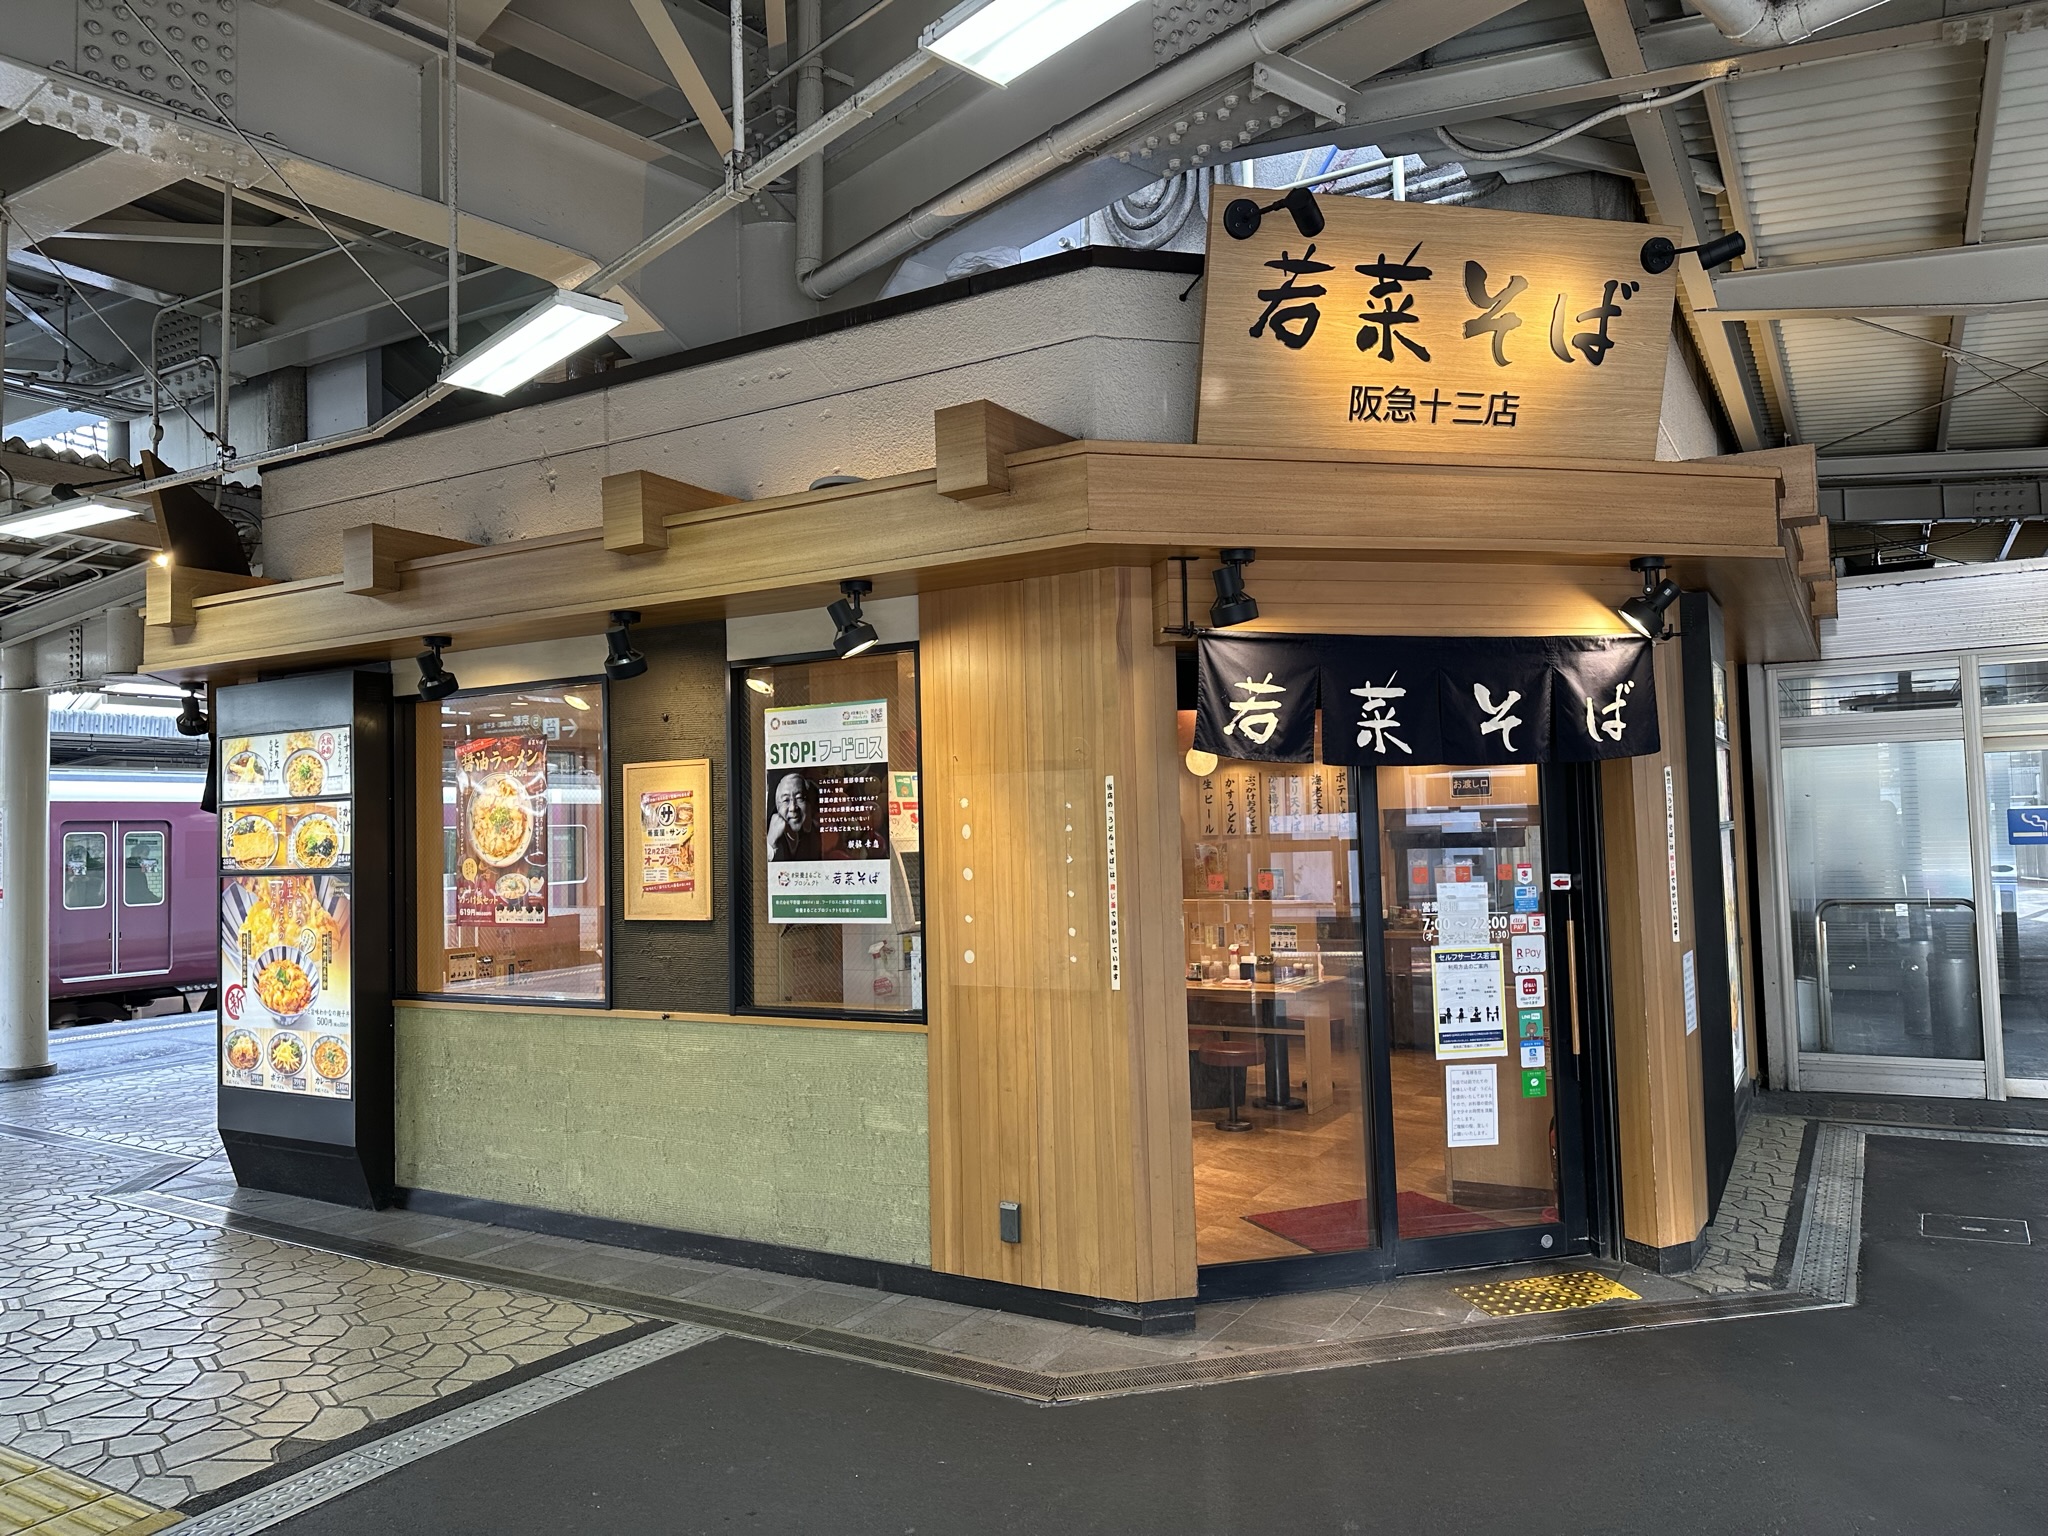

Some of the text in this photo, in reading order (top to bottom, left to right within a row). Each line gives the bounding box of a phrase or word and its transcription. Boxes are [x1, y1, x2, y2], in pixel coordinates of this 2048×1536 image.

[1249, 241, 1640, 367] 若菜そば
[1349, 386, 1520, 427] 阪急十三店
[1223, 670, 1637, 754] 若菜そば
[461, 748, 539, 772] 醤油ラーメン
[770, 736, 883, 765] STOP! フードロス
[1202, 778, 1214, 834] 生ビール
[1225, 778, 1237, 834] かすうどん
[1245, 775, 1257, 833] ぶっかけおろしそば
[1290, 774, 1301, 832] とり天そば
[1311, 774, 1323, 832] 海老天そば
[1336, 773, 1349, 832] ポテトそば
[1453, 779, 1489, 789] お渡し口
[661, 806, 673, 822] サ
[832, 871, 880, 885] 若菜そば
[1471, 916, 1507, 930] 22:00
[1516, 948, 1541, 958] R Pay
